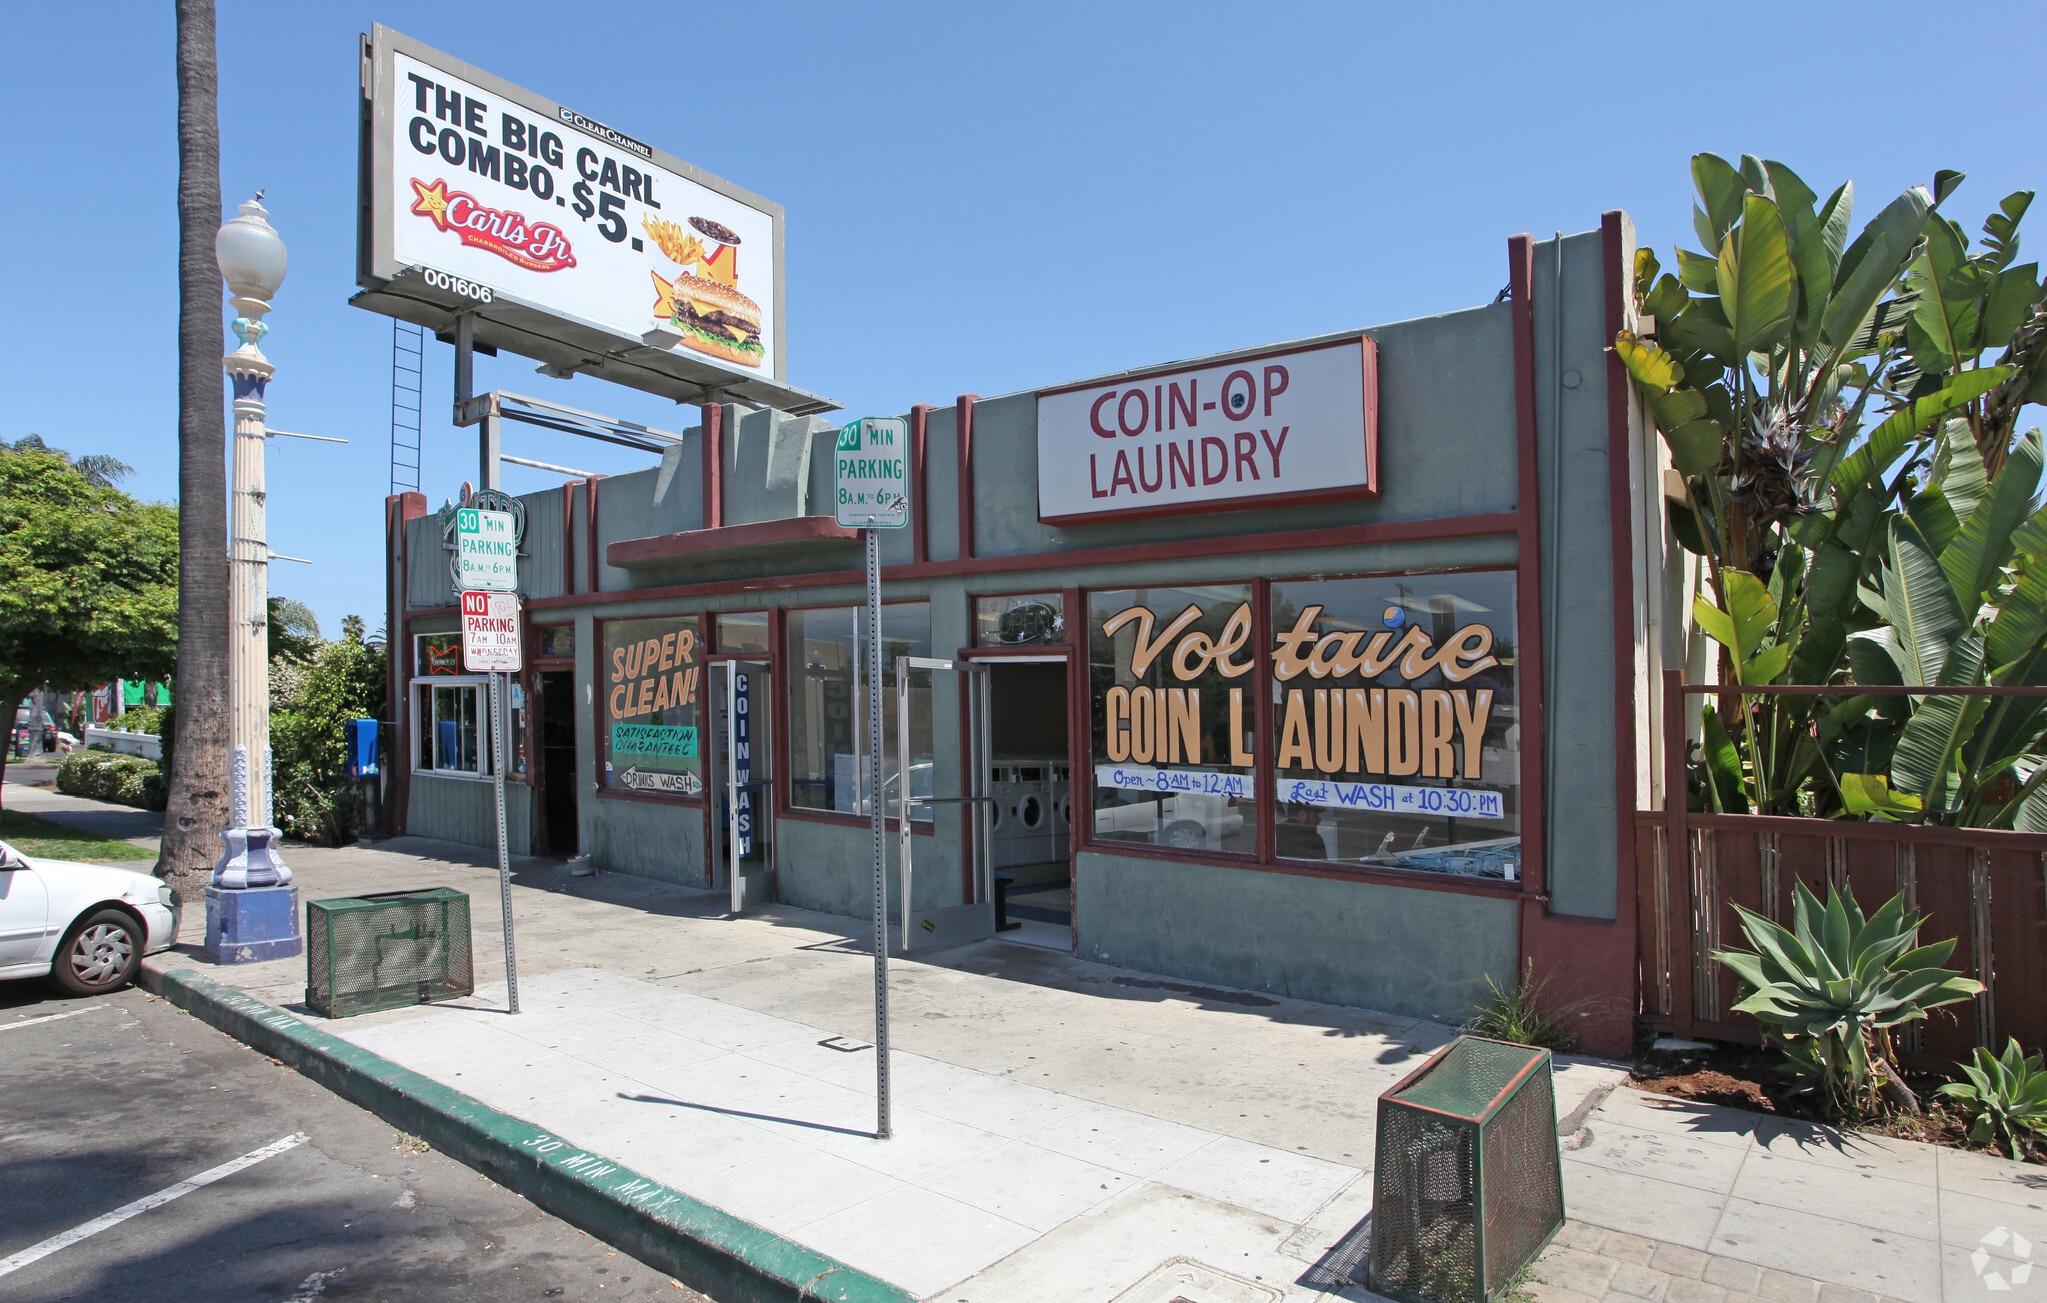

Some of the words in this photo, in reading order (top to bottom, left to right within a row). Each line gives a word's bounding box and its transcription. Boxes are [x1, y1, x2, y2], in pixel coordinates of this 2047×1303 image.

[408, 72, 487, 138] THE
[502, 112, 563, 170] BIG
[576, 147, 661, 209] CARL
[408, 116, 565, 206] COMBO.
[573, 179, 643, 252] $5.
[446, 196, 528, 244] Carl's
[529, 226, 573, 263] Jr.
[468, 235, 518, 261] CHARBROILED
[424, 269, 492, 303] 001606
[1089, 364, 1290, 439] COIN-OP
[839, 425, 857, 446] 30
[870, 429, 893, 445] MIN
[839, 459, 902, 479] PARKING
[1089, 426, 1290, 499] LAUNDRY
[460, 512, 477, 530] 30
[486, 519, 504, 532] MIN
[463, 539, 512, 556] PARKING
[466, 595, 485, 612] NO
[468, 617, 514, 633] PARKING
[470, 632, 487, 644] 7AM
[496, 633, 517, 645] 10AM
[611, 630, 693, 682] SUPER
[610, 666, 699, 719] CLEAN!
[737, 674, 749, 759] COIN
[1106, 686, 1200, 764] COIN
[616, 726, 693, 741] SATISFACTION
[626, 772, 654, 787] DRINKS
[660, 775, 692, 791] WASH
[1114, 770, 1144, 787] Open
[1192, 777, 1201, 788] to
[1290, 781, 1328, 801] Last
[1334, 784, 1395, 810] WASH
[1402, 794, 1414, 804] at
[738, 769, 750, 854] WASH
[523, 1135, 563, 1152] 30
[560, 1153, 616, 1179] MIN
